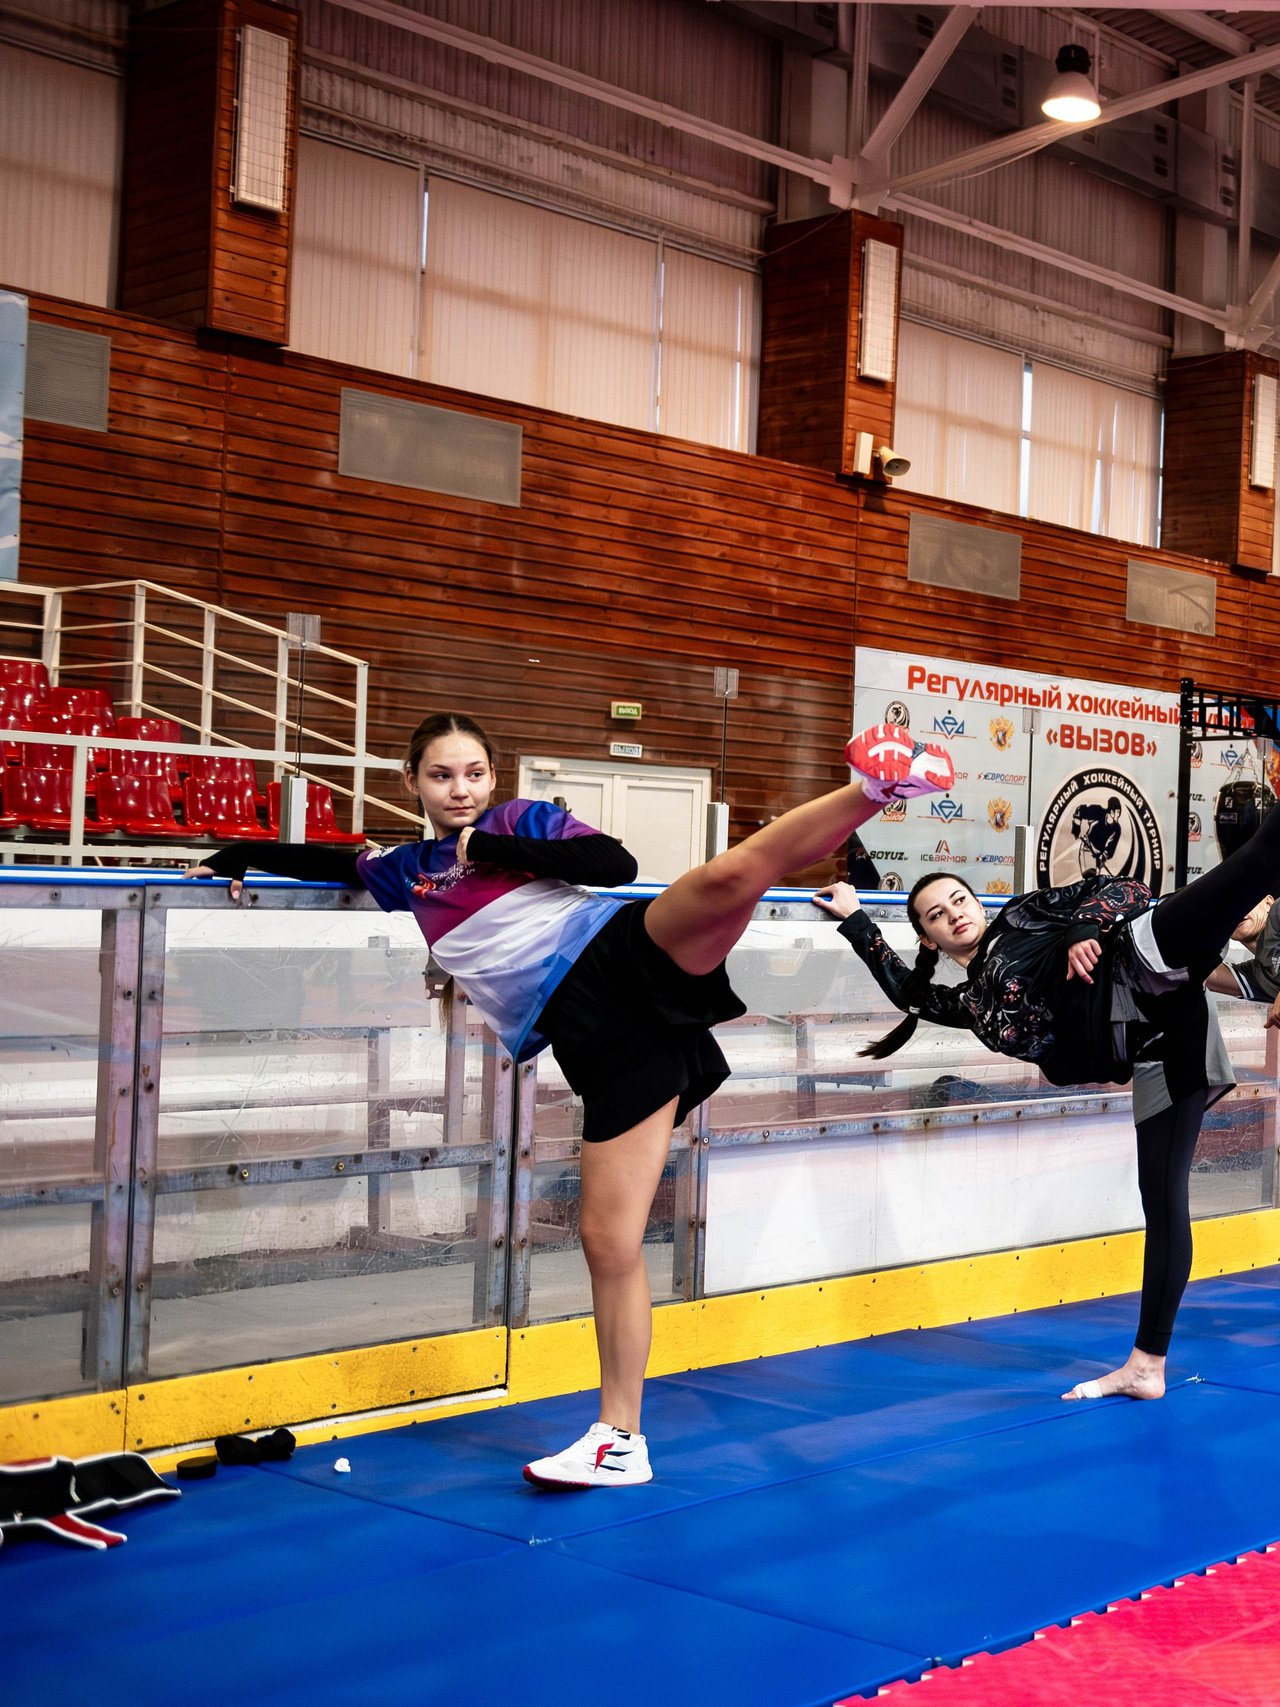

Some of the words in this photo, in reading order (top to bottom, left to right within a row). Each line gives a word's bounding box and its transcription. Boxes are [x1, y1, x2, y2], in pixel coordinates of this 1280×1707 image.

[908, 665, 1062, 710] Регулярный
[1046, 724, 1158, 757] «ВЫЗОВ»
[1039, 779, 1079, 872] РЕГУЛЯРНЫЙ
[1082, 772, 1144, 809] ХОККЕЙНЫЙ
[1143, 810, 1161, 870] ТУРНИР
[870, 850, 905, 861] SOYUZ
